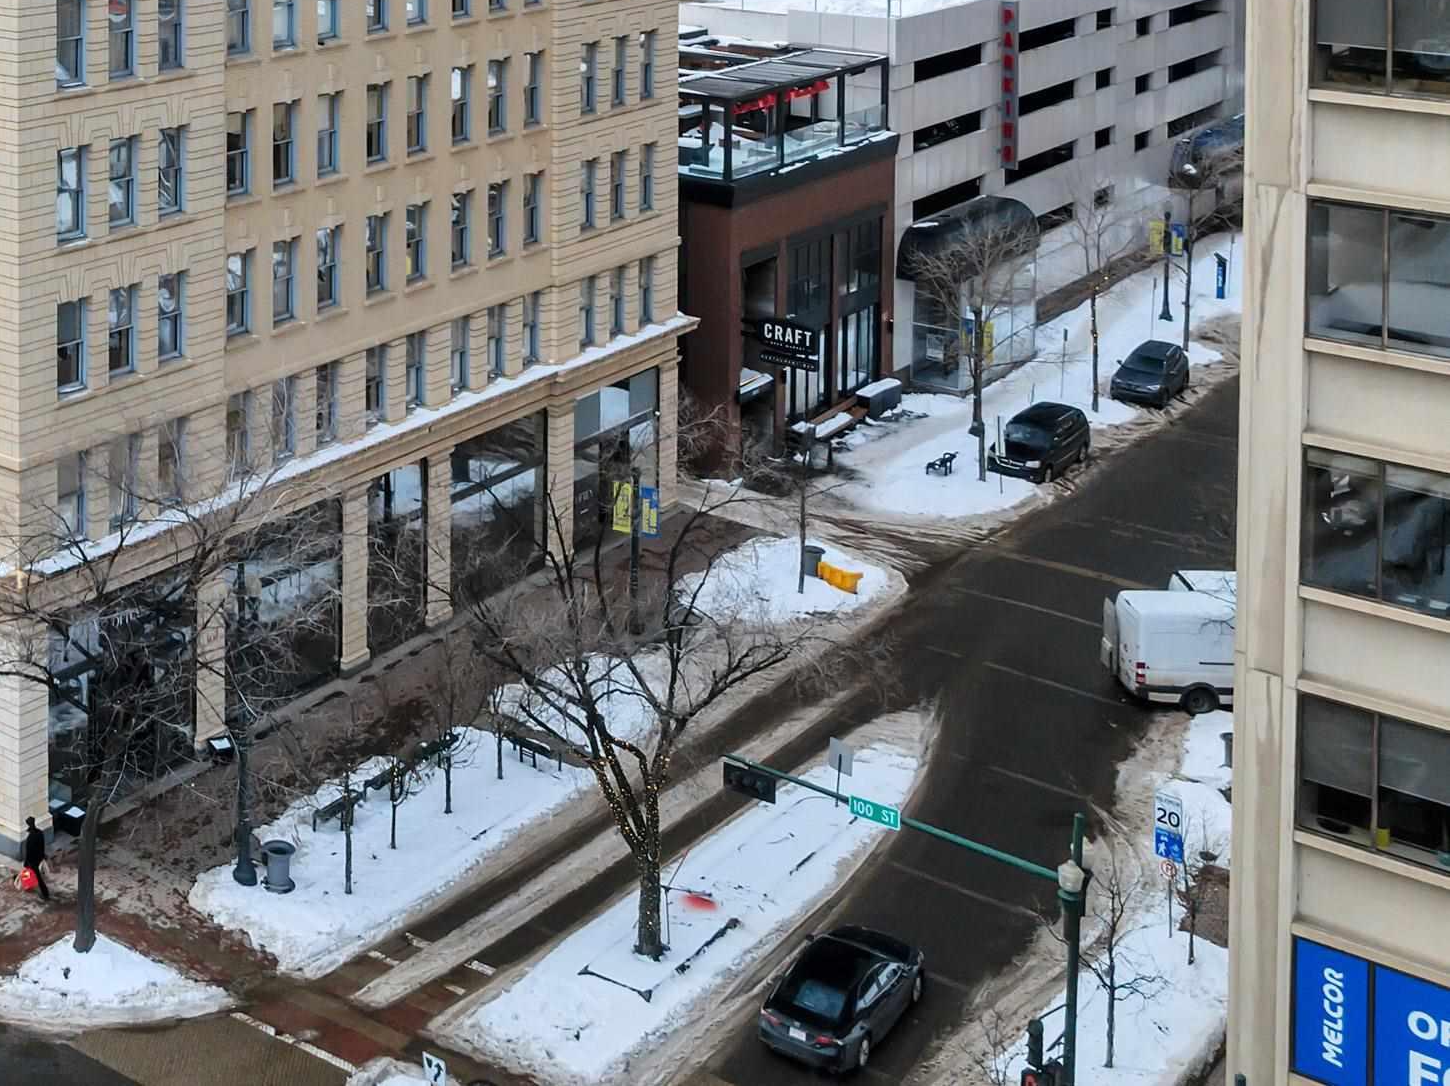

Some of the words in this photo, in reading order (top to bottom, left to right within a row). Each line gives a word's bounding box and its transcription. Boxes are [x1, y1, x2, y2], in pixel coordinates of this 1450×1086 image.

[1002, 8, 1015, 162] PARKING
[764, 323, 812, 347] CRAFT
[853, 800, 874, 817] 100
[881, 810, 896, 825] ST
[1157, 807, 1180, 828] 20
[1322, 967, 1344, 1068] MELCOR
